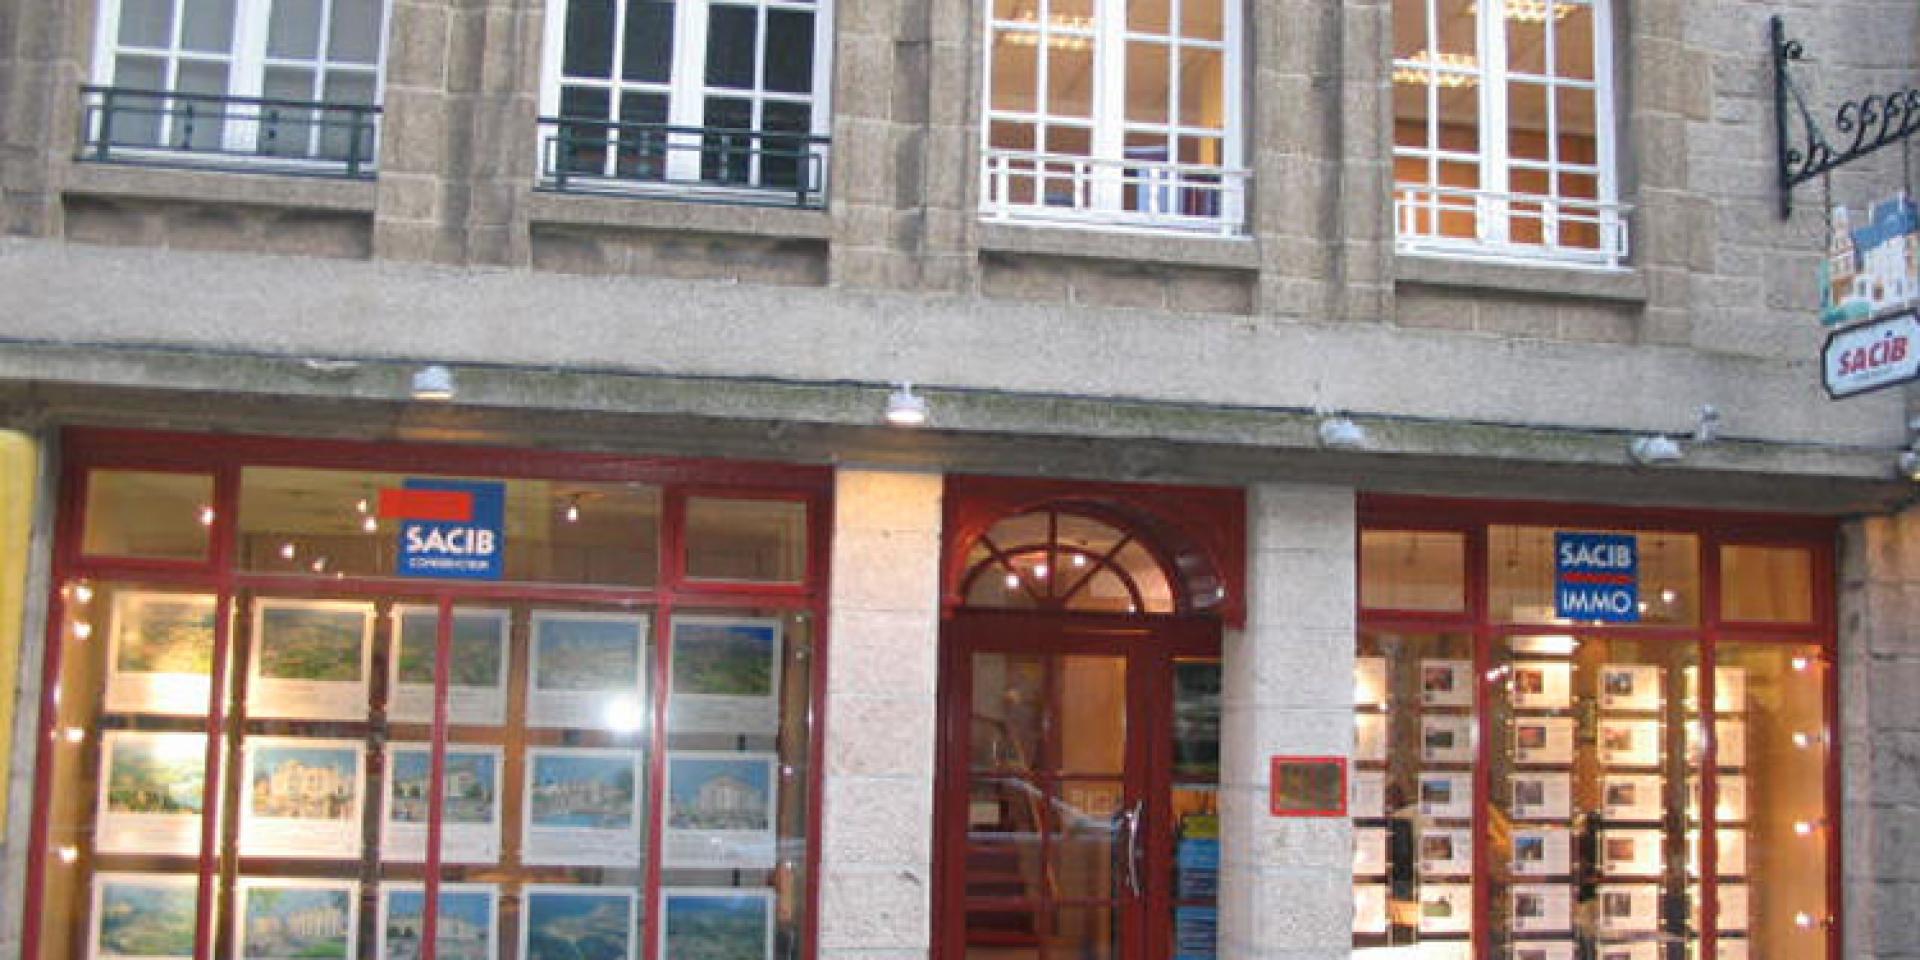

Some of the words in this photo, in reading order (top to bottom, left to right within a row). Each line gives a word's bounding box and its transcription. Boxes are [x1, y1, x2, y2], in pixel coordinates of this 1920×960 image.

[406, 525, 493, 554] SACIB
[1561, 542, 1631, 568] SACIB
[1563, 588, 1631, 614] IMMO
